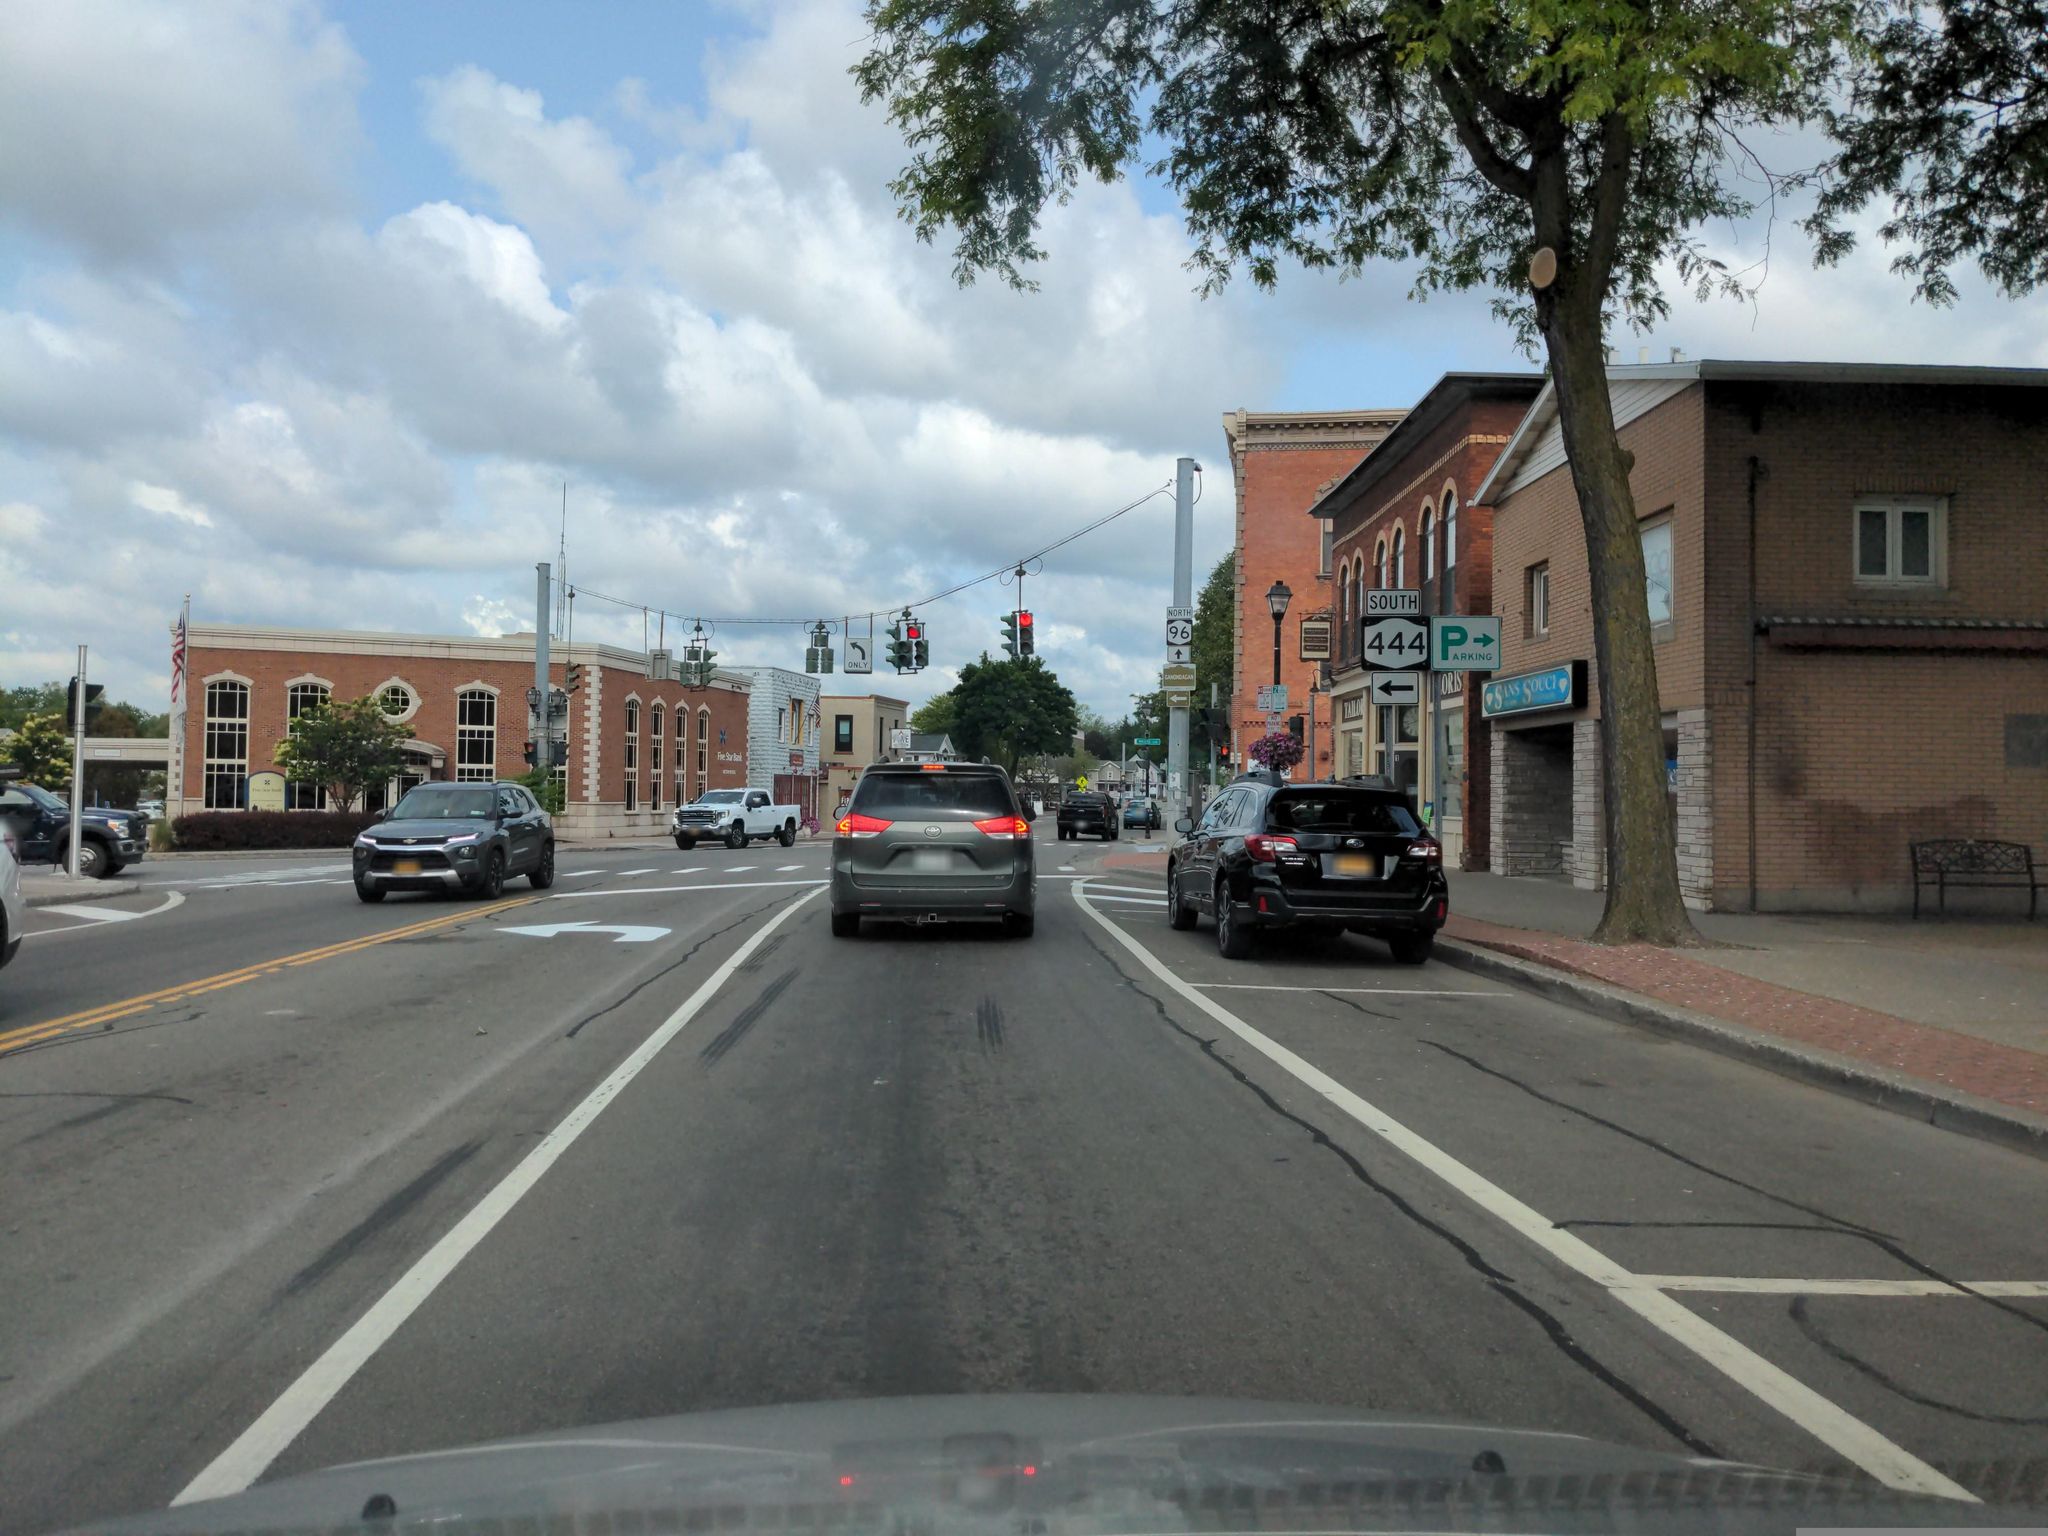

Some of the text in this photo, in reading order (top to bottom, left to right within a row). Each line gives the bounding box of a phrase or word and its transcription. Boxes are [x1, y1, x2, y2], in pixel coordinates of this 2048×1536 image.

[1369, 595, 1418, 610] SOUTH
[1168, 609, 1191, 617] NORTH
[1169, 626, 1190, 640] 96
[1367, 632, 1425, 655] 444
[847, 661, 869, 669] ONLY
[1494, 674, 1556, 710] SANS SOUCI
[734, 752, 743, 762] Bank
